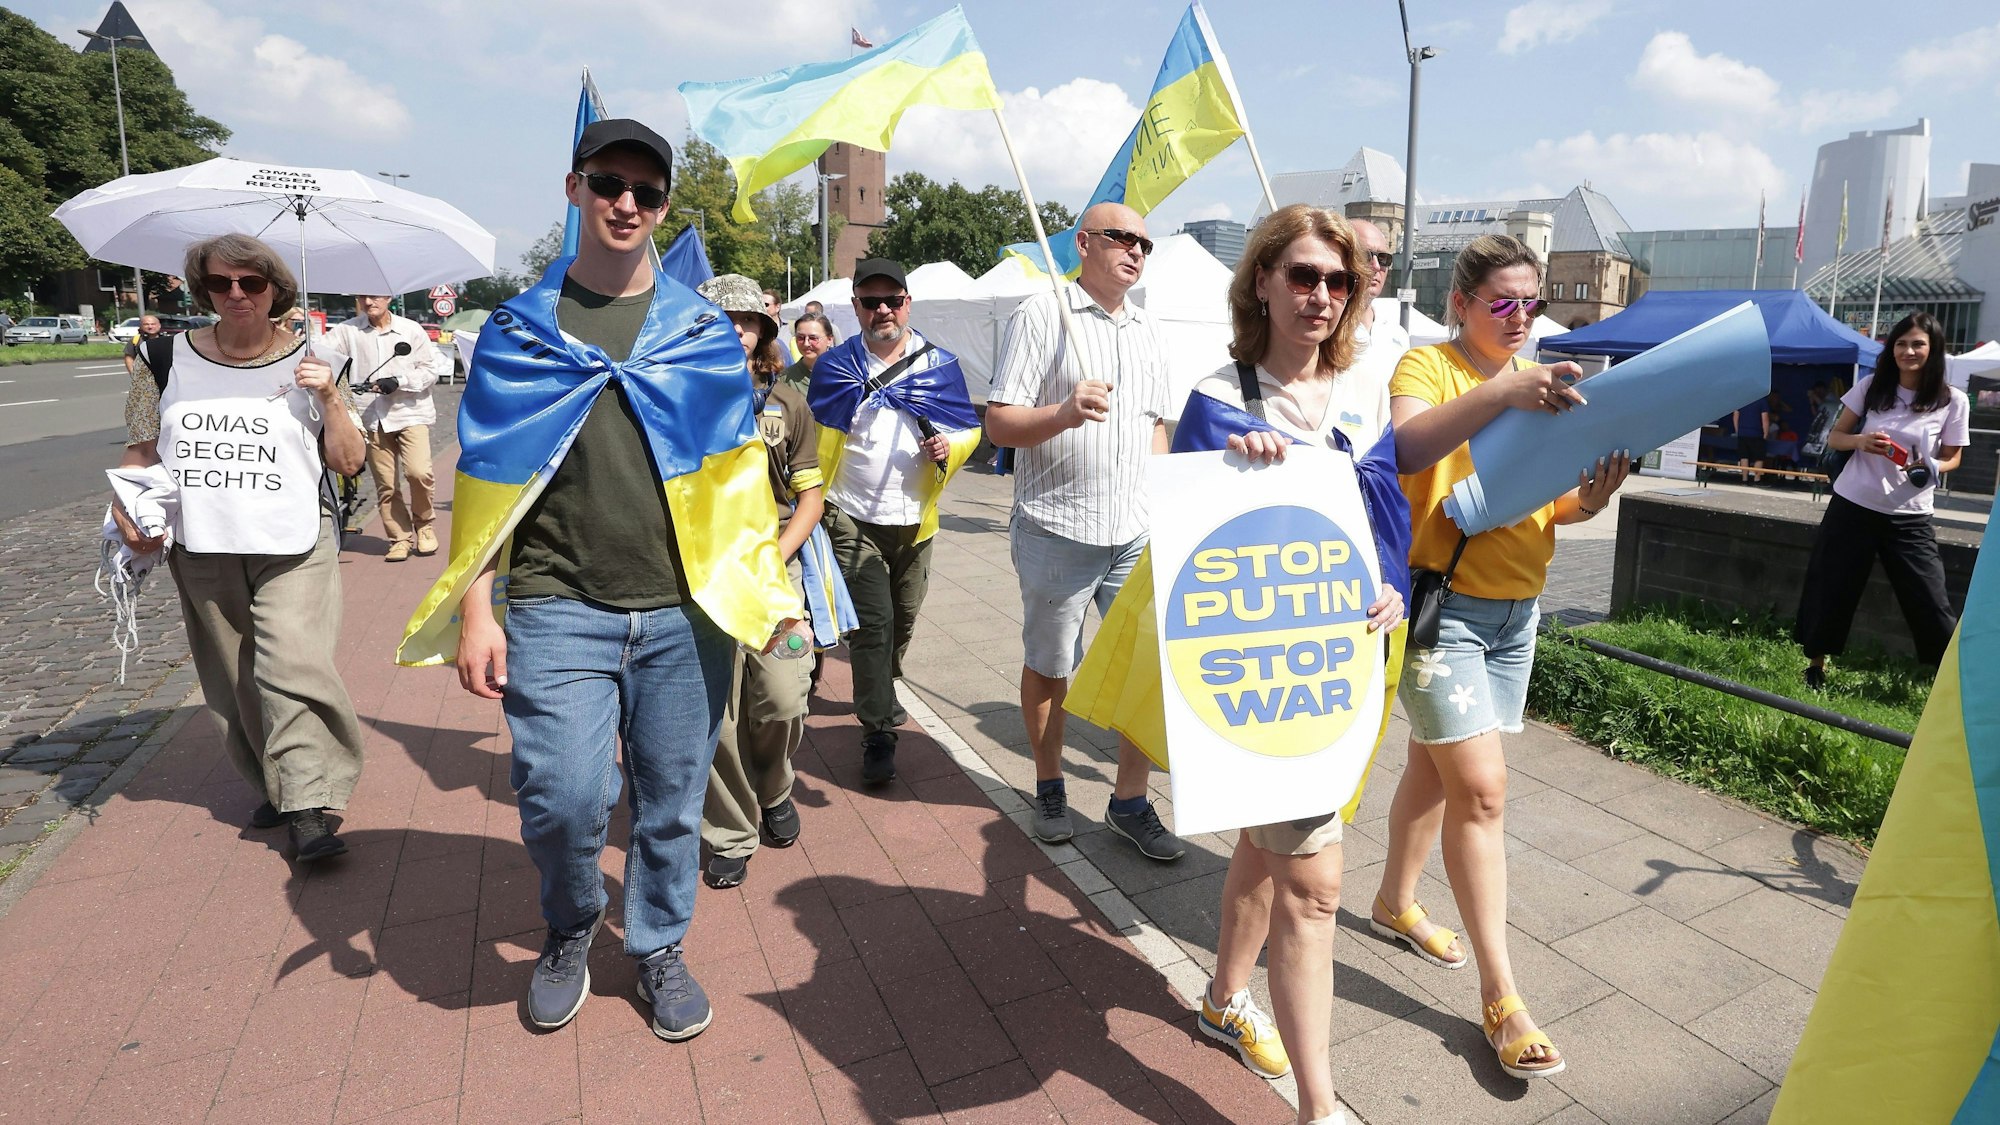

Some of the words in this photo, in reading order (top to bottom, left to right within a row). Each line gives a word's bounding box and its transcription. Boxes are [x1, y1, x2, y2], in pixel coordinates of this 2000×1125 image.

[252, 174, 317, 184] GEGEN
[258, 169, 312, 178] OMAS
[245, 180, 321, 192] RECHTS
[439, 303, 450, 311] 40
[181, 412, 269, 435] OMAS
[175, 440, 277, 464] GEGEN
[1193, 539, 1351, 583] STOP
[1183, 579, 1362, 627] PUTIN
[1200, 637, 1354, 686] STOP
[1213, 678, 1353, 727] WAR
